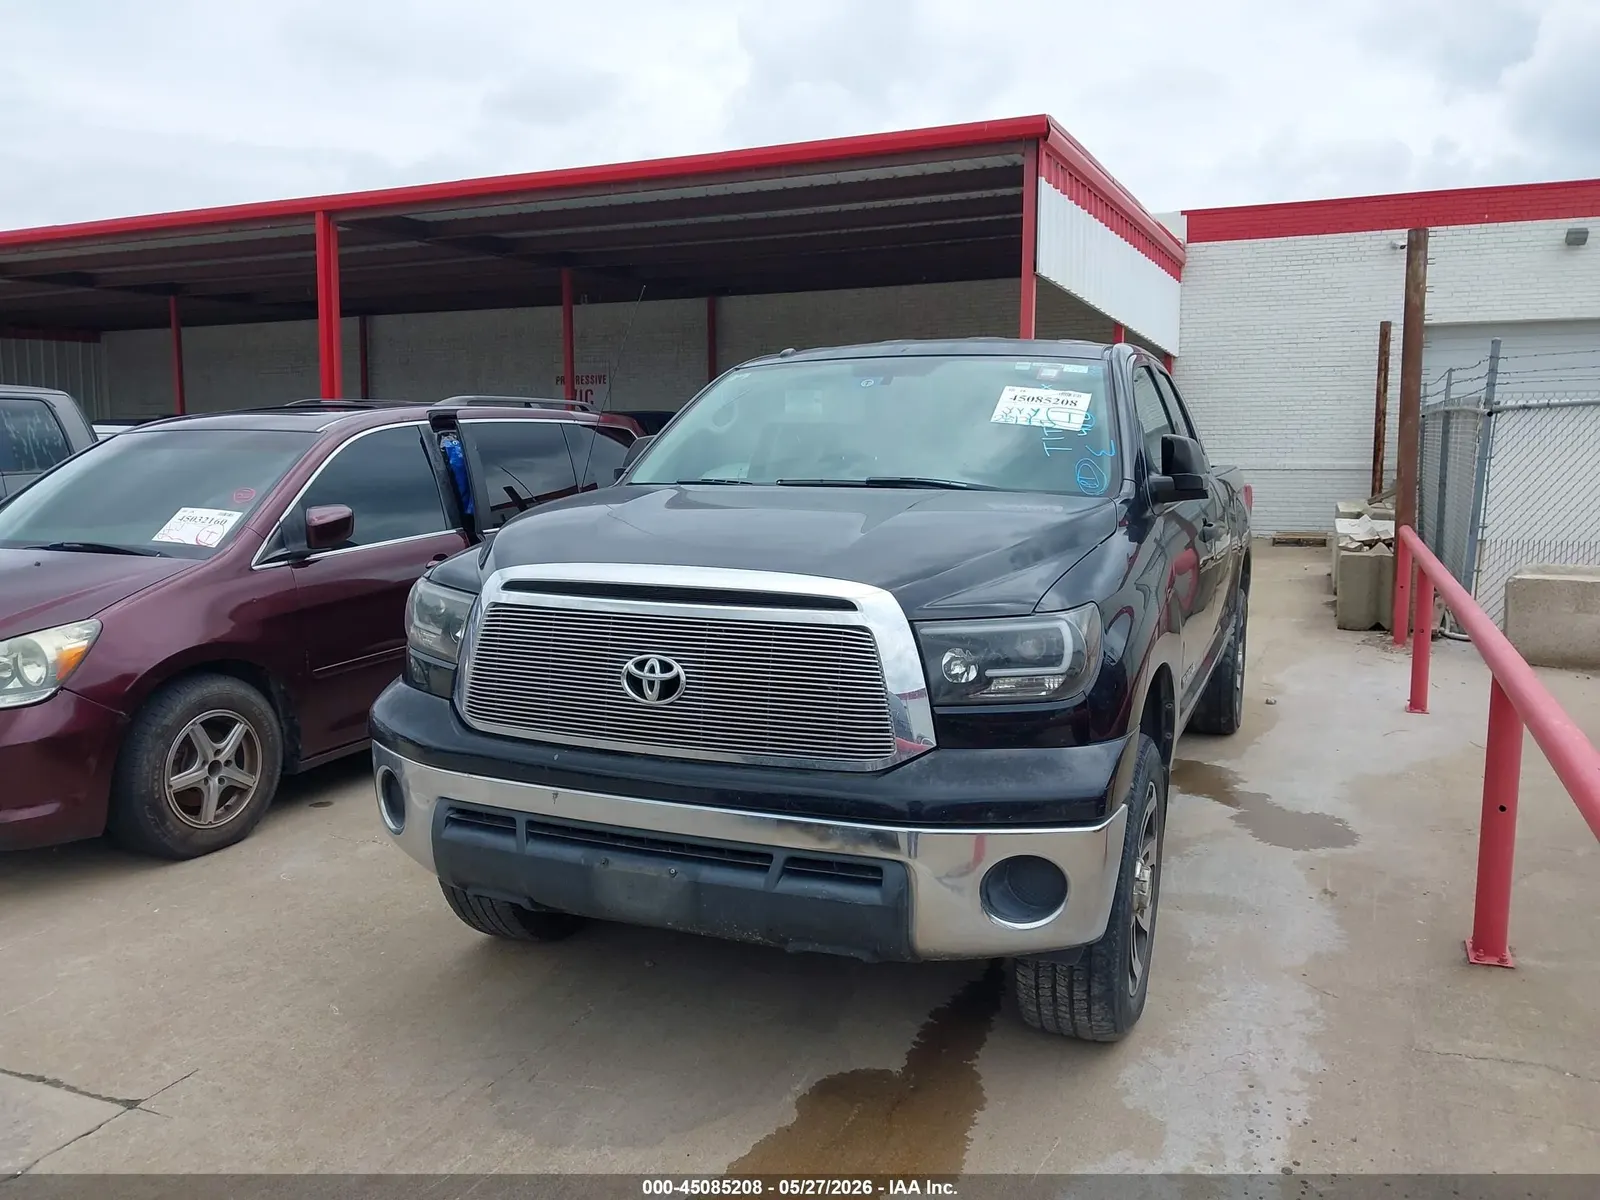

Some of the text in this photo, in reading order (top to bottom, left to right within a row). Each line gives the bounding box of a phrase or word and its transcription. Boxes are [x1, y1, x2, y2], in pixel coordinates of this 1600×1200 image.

[555, 374, 607, 386] PRRESSIVE
[574, 388, 594, 405] IC
[1010, 394, 1079, 407] 45085208
